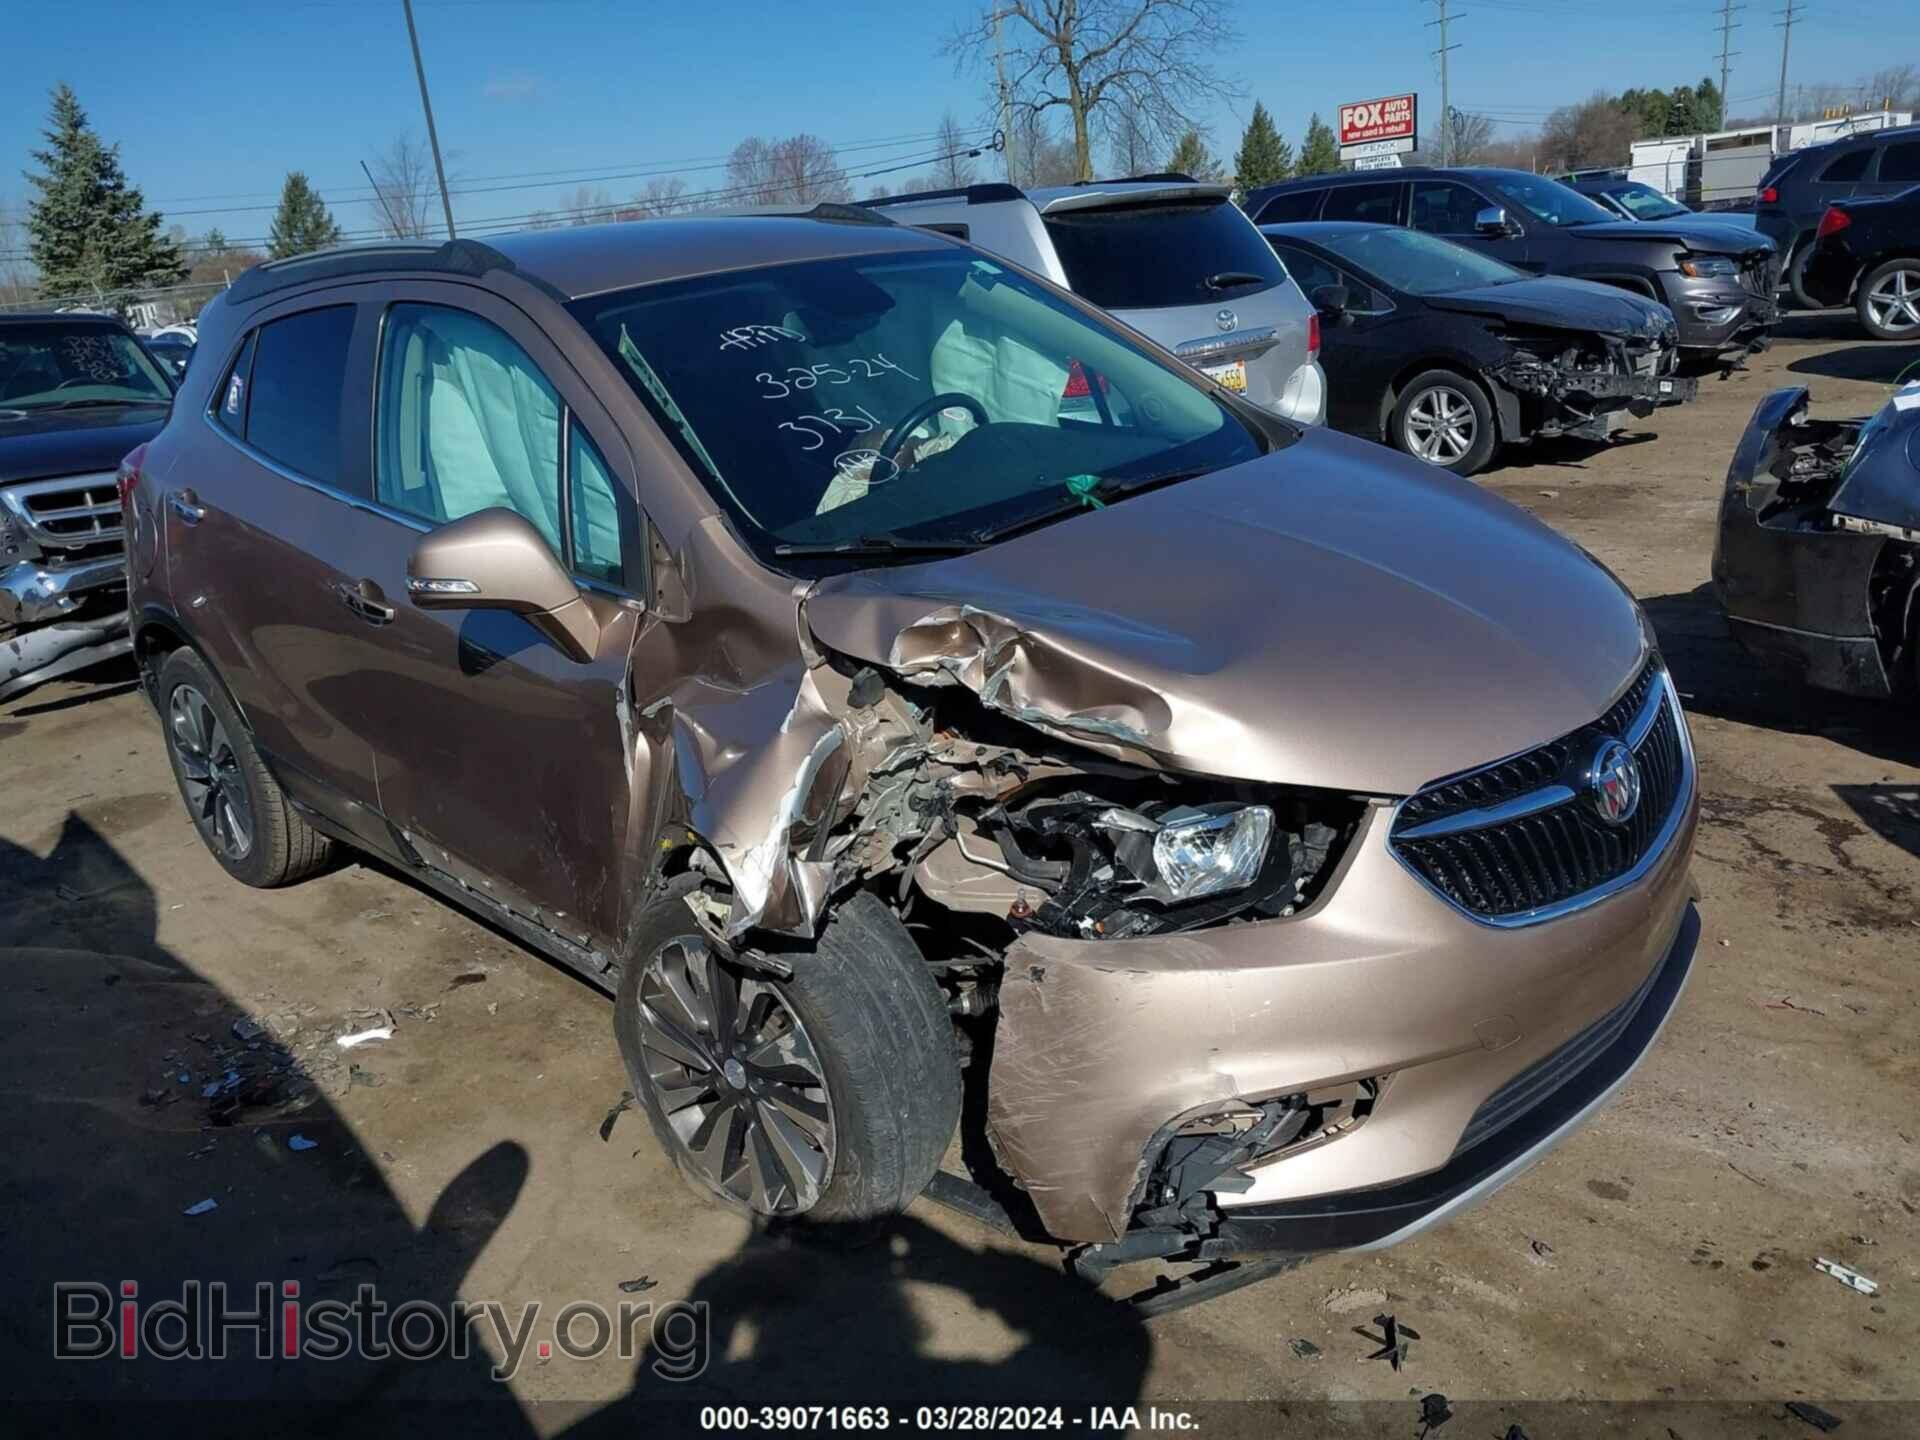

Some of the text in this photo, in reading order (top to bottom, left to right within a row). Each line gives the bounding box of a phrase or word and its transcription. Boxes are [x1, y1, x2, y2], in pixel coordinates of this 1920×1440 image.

[1384, 99, 1408, 113] AUTO
[1342, 103, 1383, 131] FOX
[1383, 110, 1411, 124] PARTS
[1378, 125, 1384, 136] &
